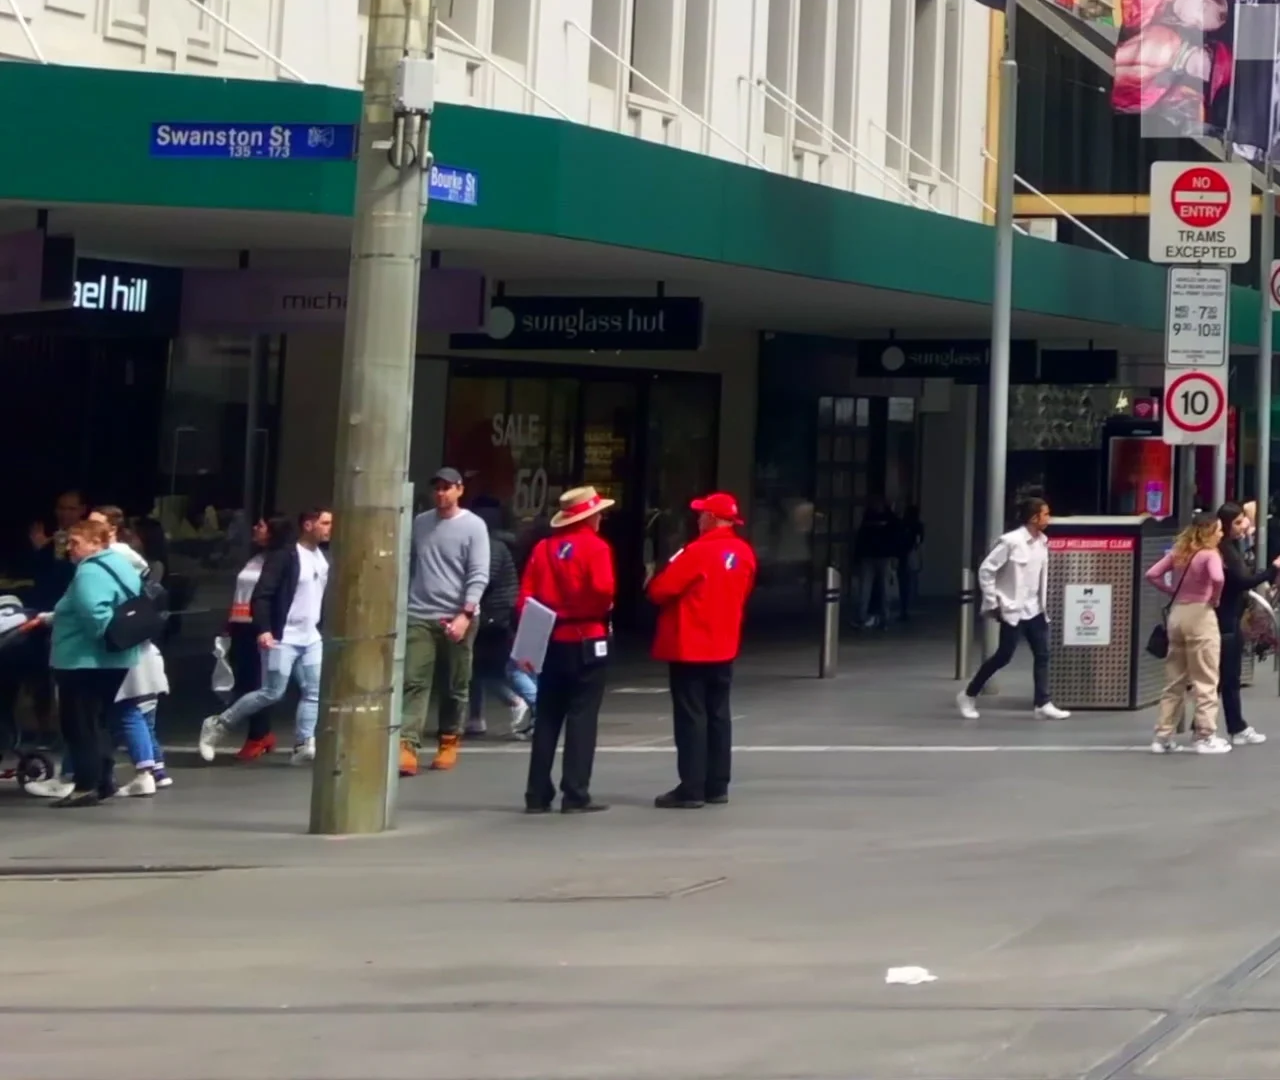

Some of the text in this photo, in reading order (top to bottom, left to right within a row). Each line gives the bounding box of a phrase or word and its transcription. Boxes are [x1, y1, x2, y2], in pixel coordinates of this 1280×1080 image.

[156, 125, 292, 147] Swanston St
[229, 146, 251, 158] 135
[269, 146, 290, 158] 173
[431, 166, 476, 192] Bourke St
[1191, 176, 1211, 189] NO
[1180, 206, 1223, 218] ENTRY
[1178, 230, 1226, 243] TRAMS
[1165, 246, 1237, 259] EXCEPTED
[72, 275, 147, 312] ael hill
[1198, 306, 1207, 320] 7
[521, 308, 666, 338] sunglass hut
[1172, 323, 1181, 337] 9
[1198, 324, 1211, 337] 10
[909, 347, 981, 366] sunglass
[1180, 390, 1209, 415] 10
[491, 413, 541, 448] SALE
[1109, 539, 1133, 548] CLEAN
